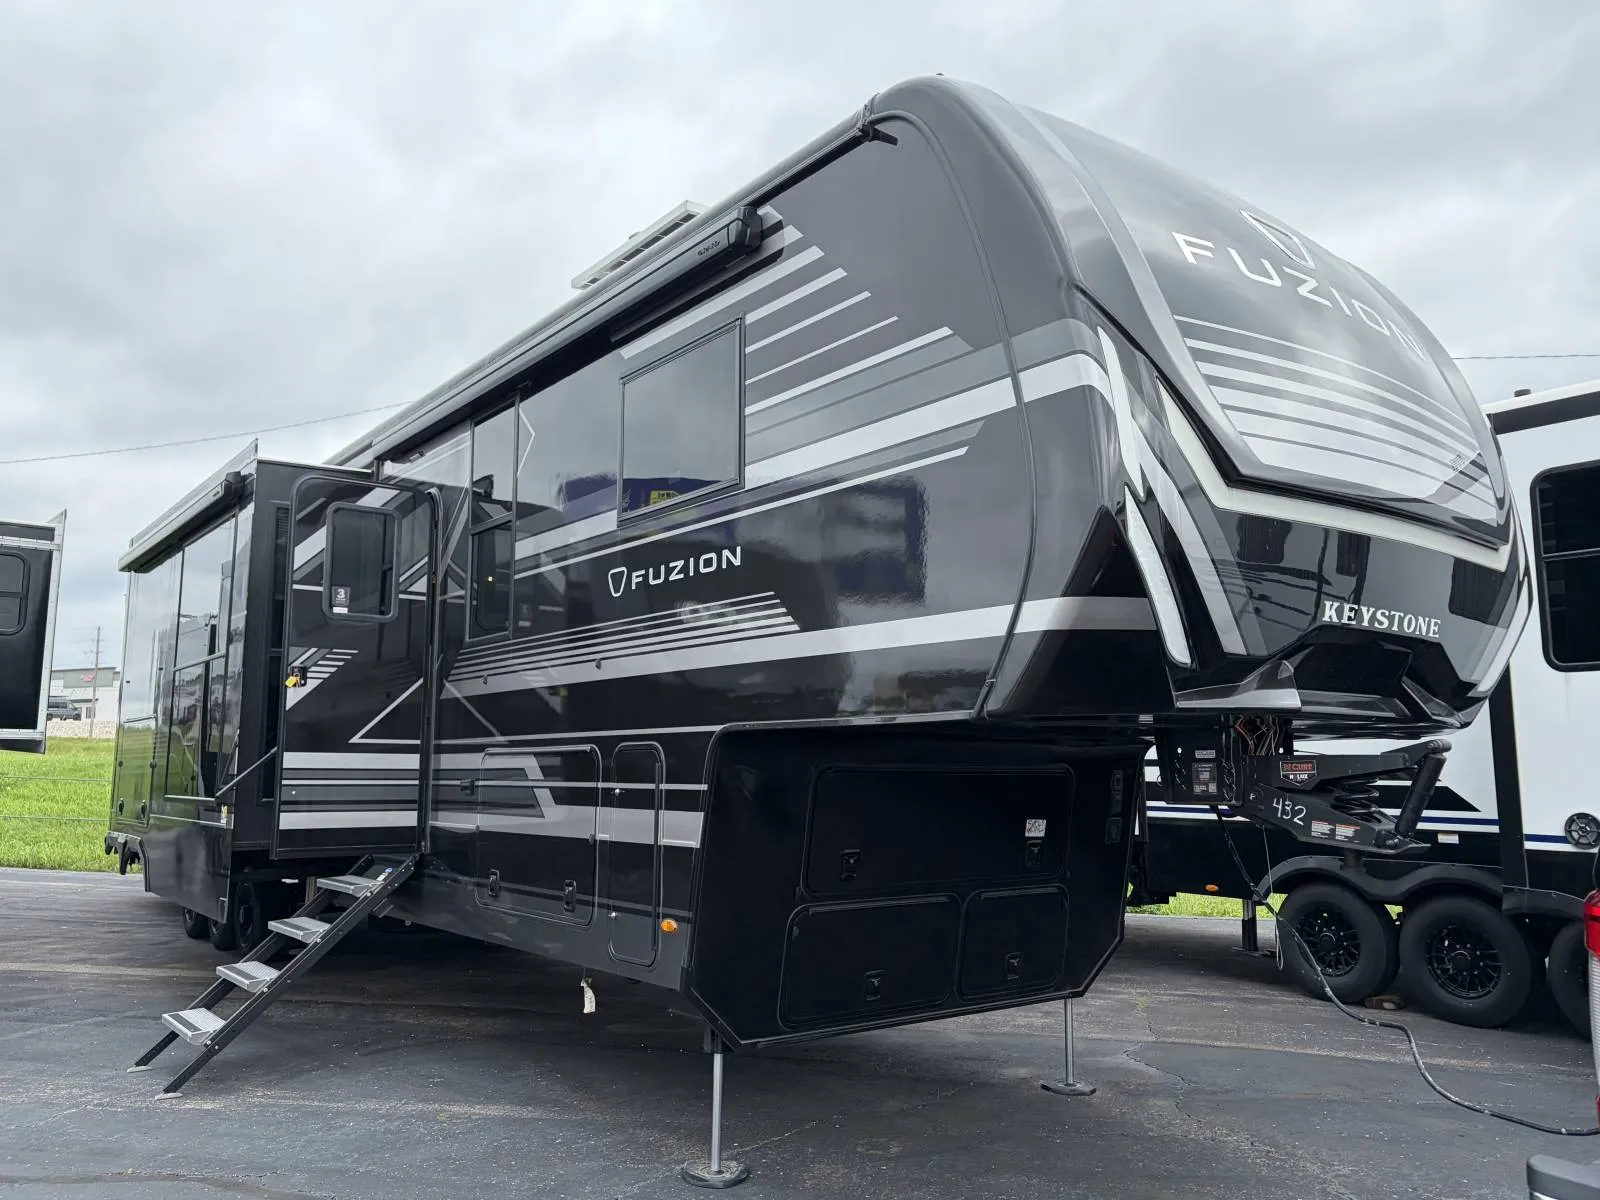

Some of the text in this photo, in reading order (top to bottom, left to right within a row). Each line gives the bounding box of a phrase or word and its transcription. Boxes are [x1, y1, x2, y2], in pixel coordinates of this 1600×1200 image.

[1171, 231, 1427, 362] FUZION
[631, 545, 742, 590] FUZION
[336, 588, 346, 599] 3
[1322, 600, 1441, 638] KEYSTONE
[1272, 797, 1307, 826] 432
